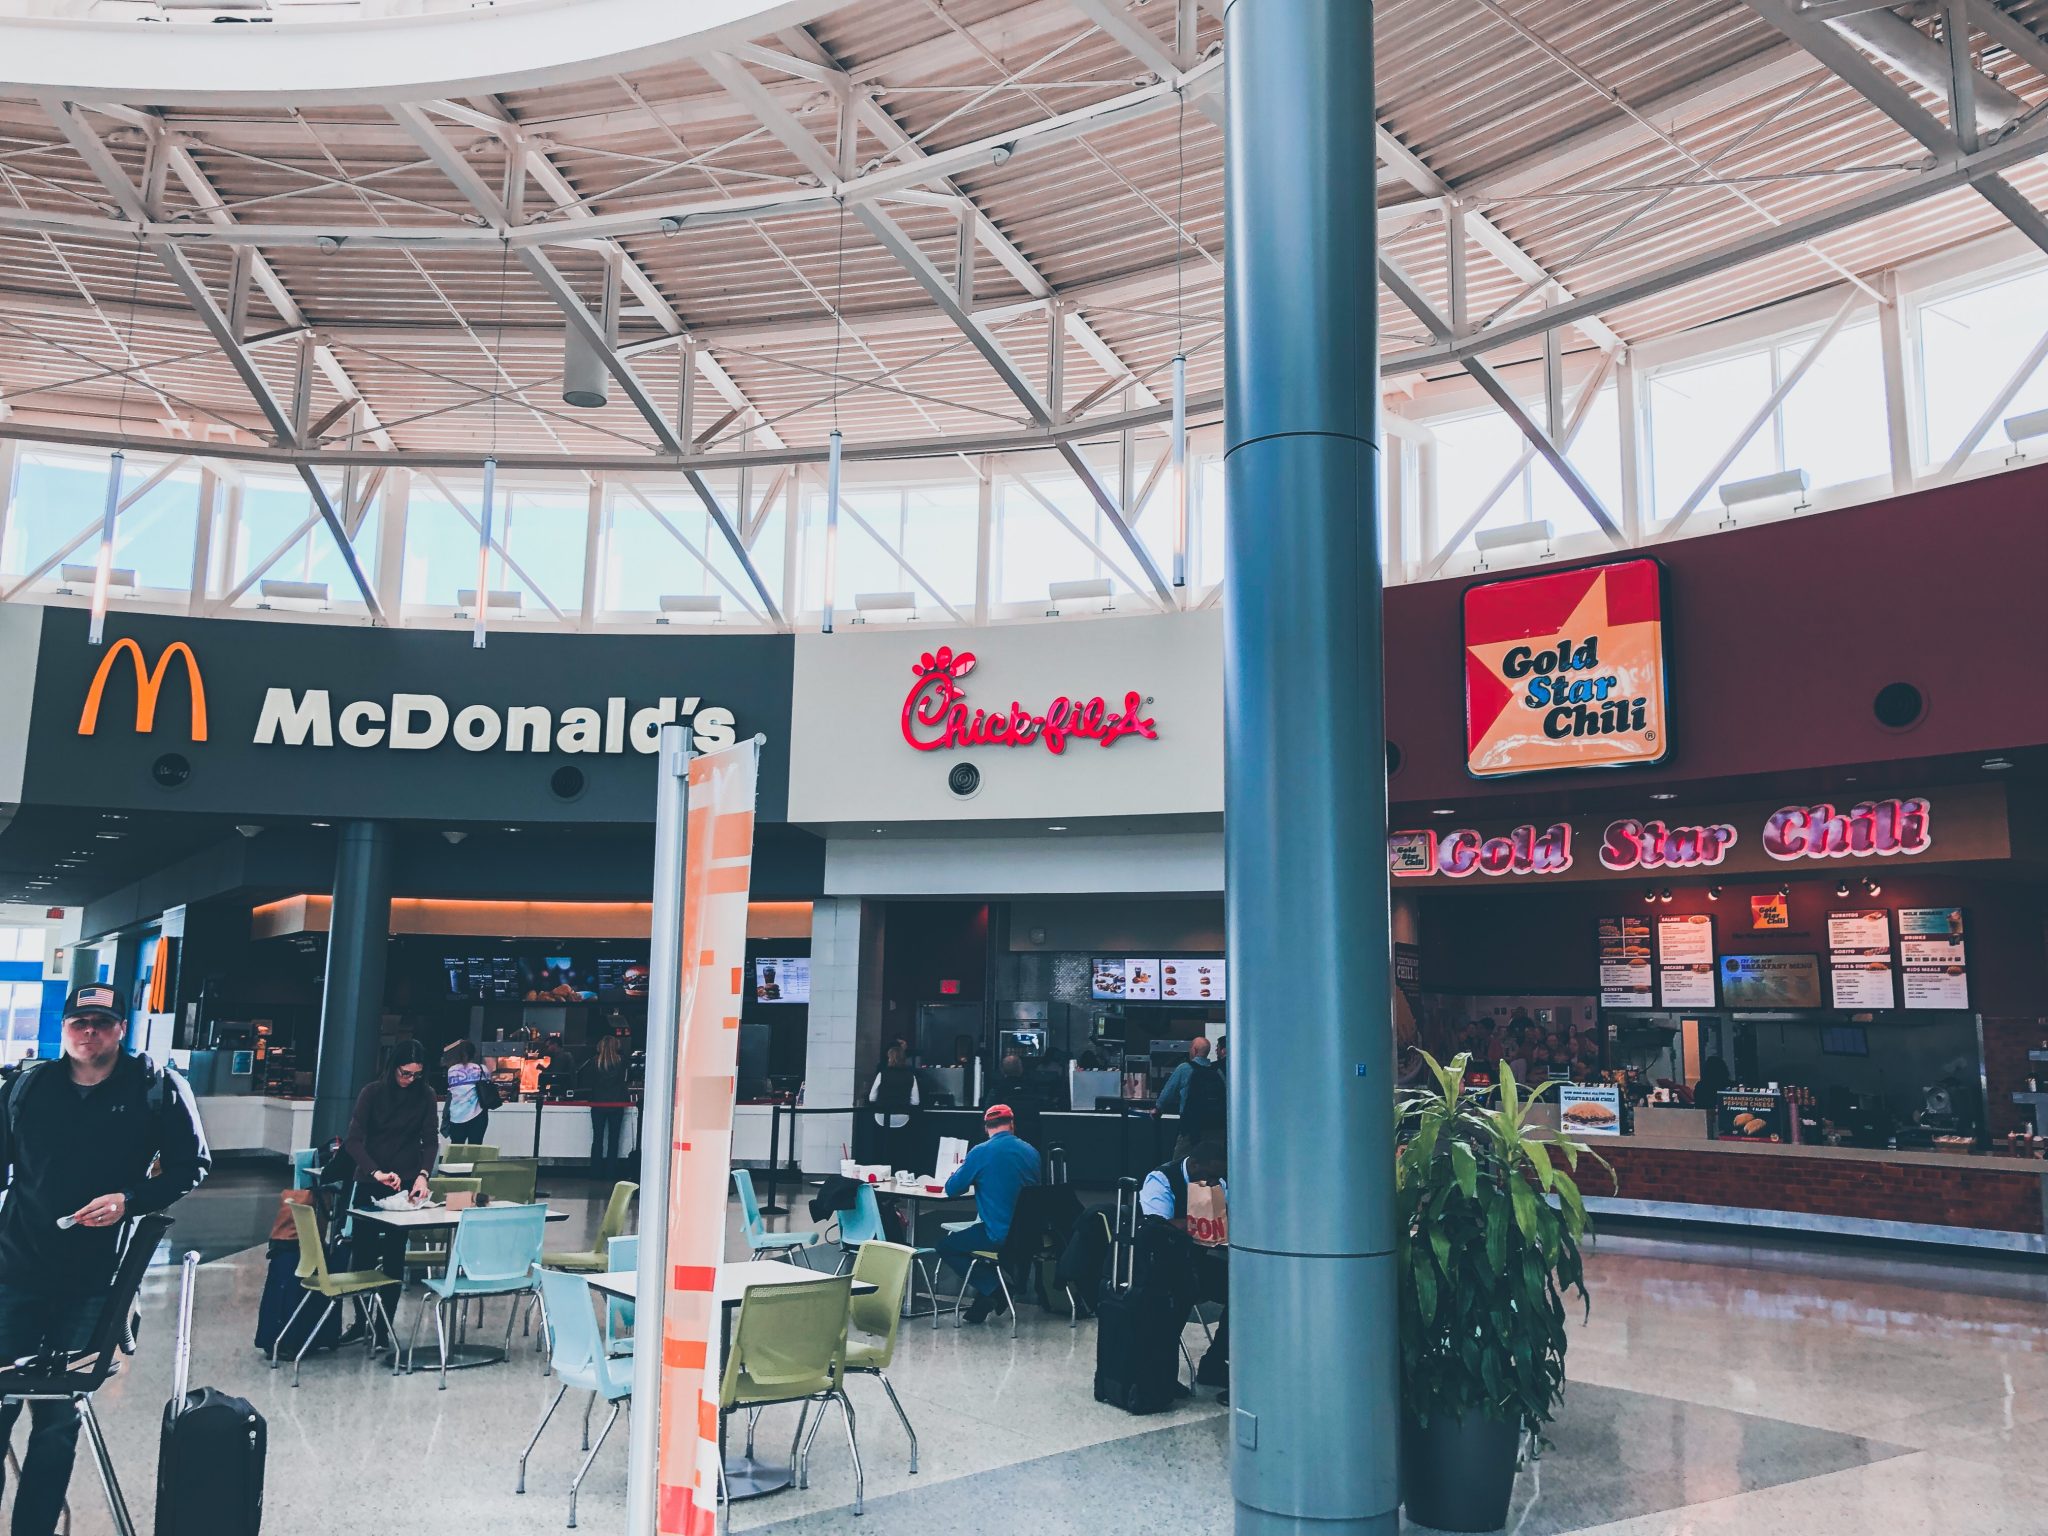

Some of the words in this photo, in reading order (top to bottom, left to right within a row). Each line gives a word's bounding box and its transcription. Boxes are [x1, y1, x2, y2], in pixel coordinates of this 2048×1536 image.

[1502, 635, 1599, 679] Gold
[902, 646, 1158, 755] Chick-fil-A
[1525, 675, 1617, 709] Star
[253, 687, 736, 754] McDonald's
[1543, 697, 1647, 739] Chili
[1438, 823, 1573, 877] Gold
[1600, 819, 1737, 870] Star
[1763, 798, 1931, 861] Chili
[1767, 917, 1786, 925] Chili
